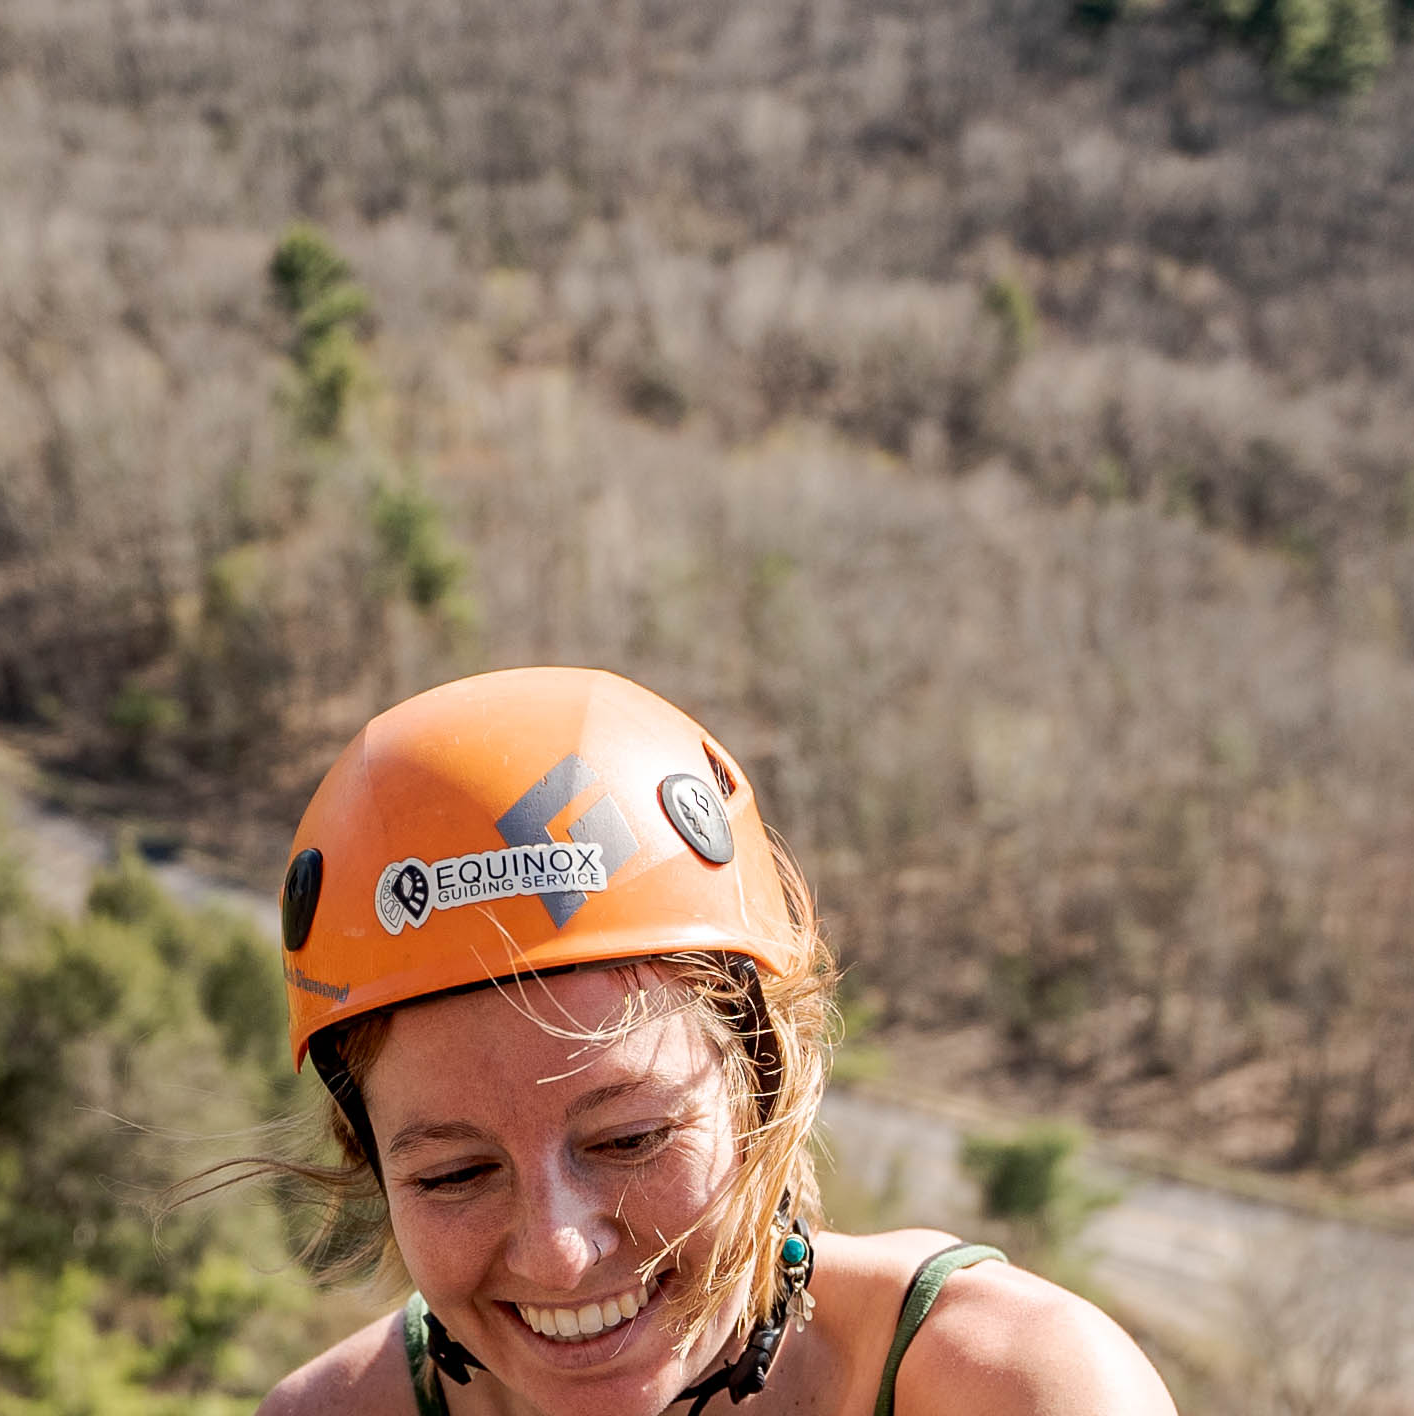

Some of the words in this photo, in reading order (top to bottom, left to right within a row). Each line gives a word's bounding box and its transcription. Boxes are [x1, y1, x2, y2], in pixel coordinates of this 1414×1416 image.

[436, 849, 598, 890] EQUINOX
[438, 882, 516, 904] GUIDING
[522, 873, 601, 890] SERVICE
